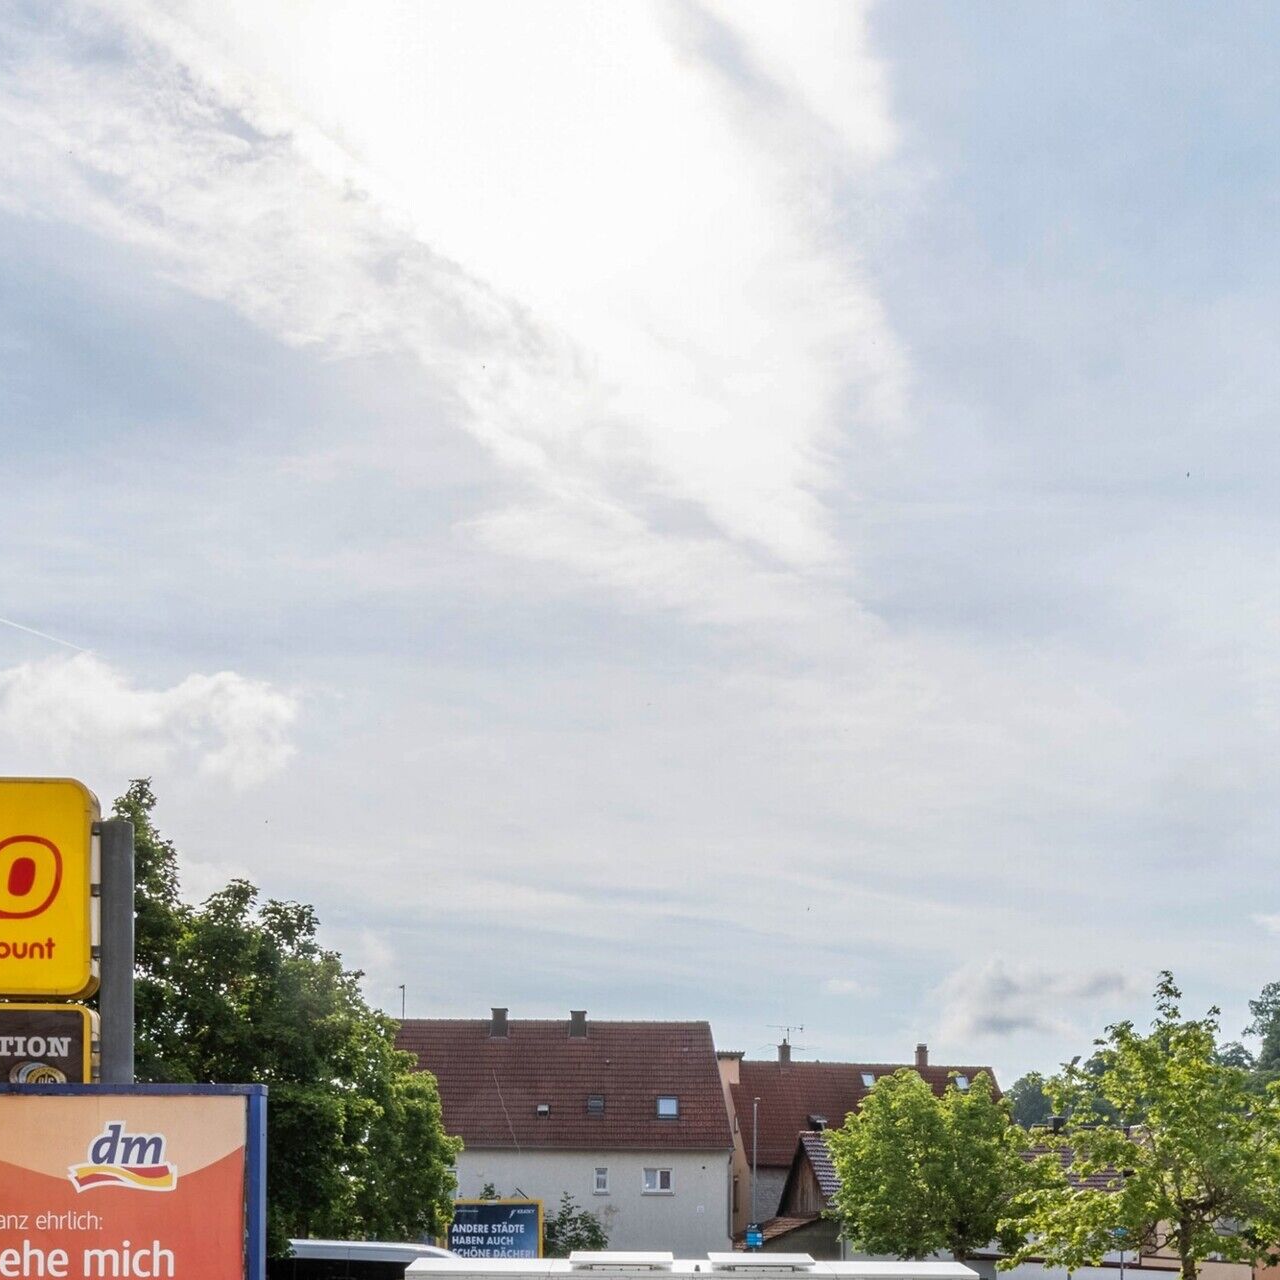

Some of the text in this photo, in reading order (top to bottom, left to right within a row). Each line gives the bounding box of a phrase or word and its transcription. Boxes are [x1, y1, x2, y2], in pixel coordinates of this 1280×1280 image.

[91, 1125, 164, 1165] dm
[35, 1210, 103, 1231] ehrlich:
[452, 1221, 525, 1234] ANDERE STÄDTE
[452, 1236, 514, 1246] HABEN AUCH
[83, 1240, 175, 1278] mich
